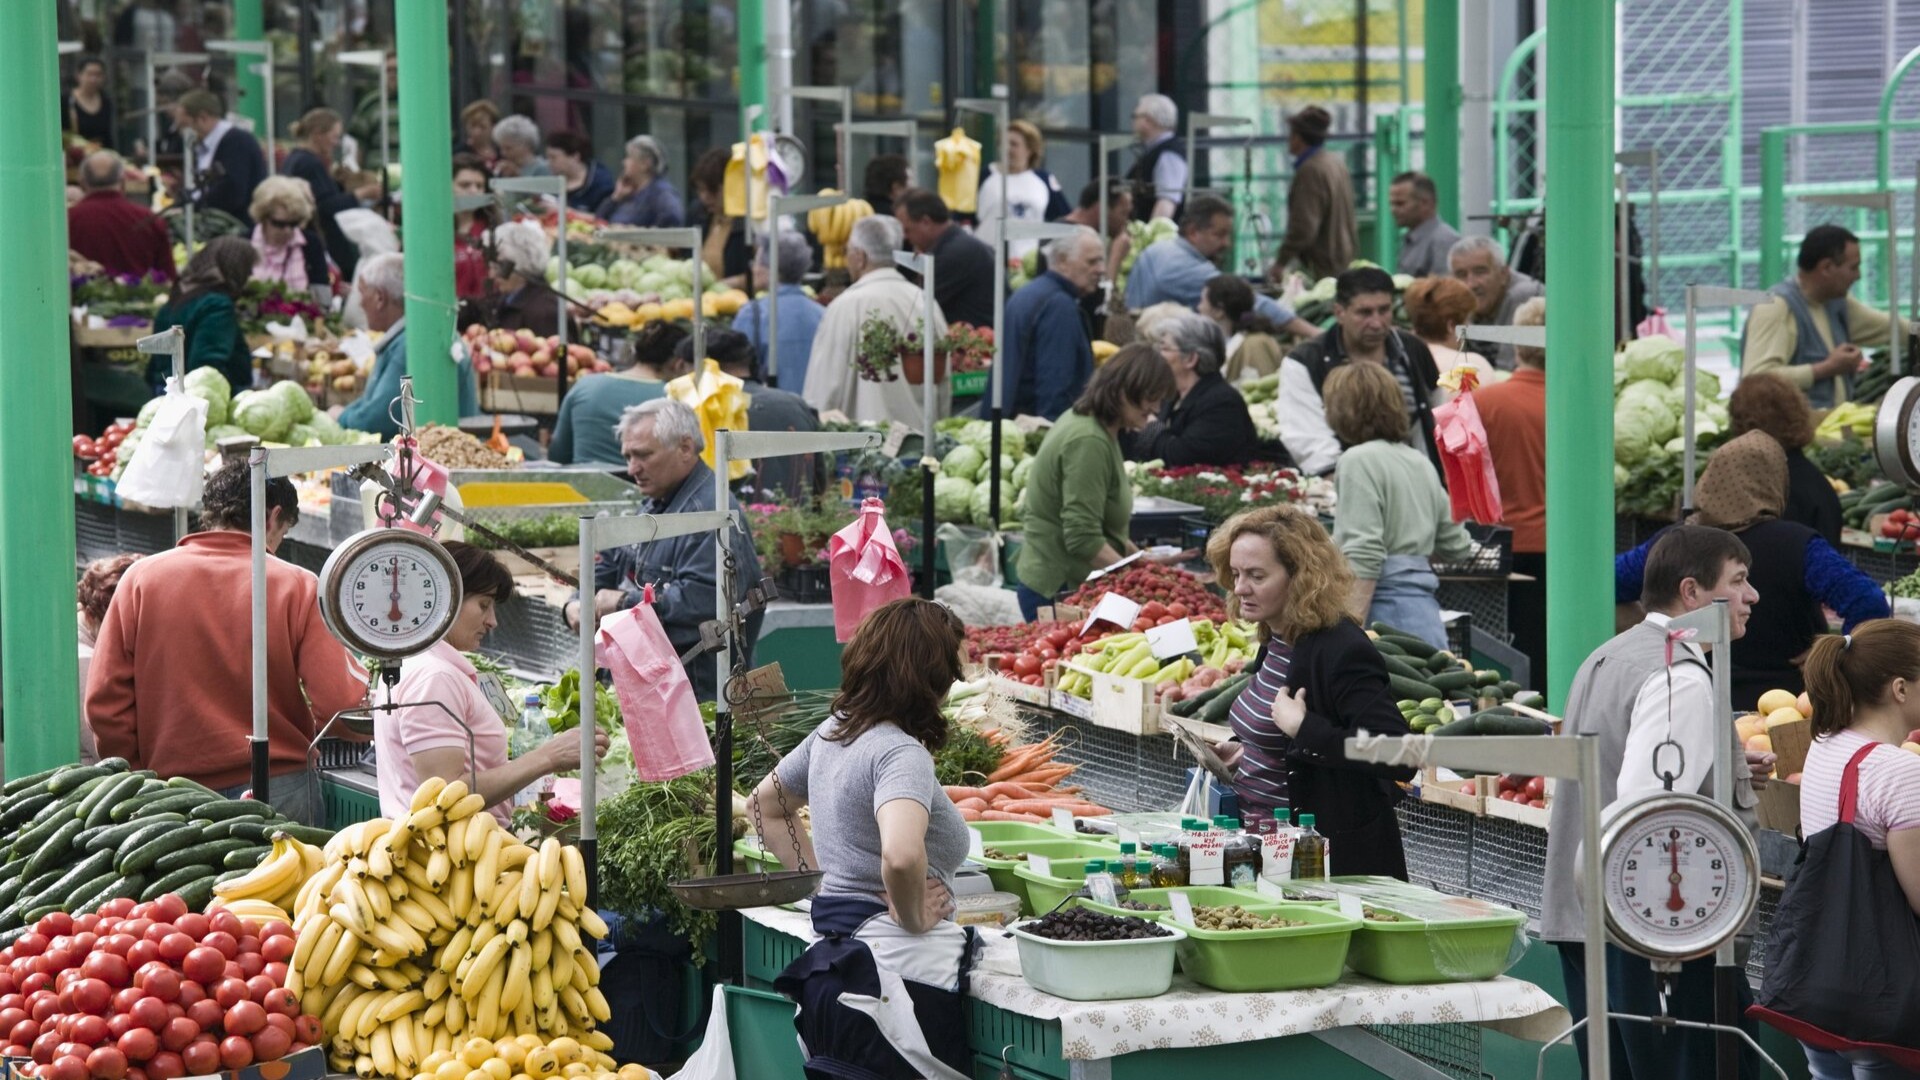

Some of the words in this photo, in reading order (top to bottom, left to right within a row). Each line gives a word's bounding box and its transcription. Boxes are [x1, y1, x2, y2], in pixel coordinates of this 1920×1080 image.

[357, 582, 365, 590] 8
[356, 603, 364, 611] 7
[370, 618, 378, 626] 6
[412, 617, 419, 625] 4
[480, 676, 506, 714] 15
[1669, 830, 1680, 839] 0
[1646, 838, 1653, 847] 1
[1696, 838, 1706, 847] 9
[1627, 860, 1636, 870] 2
[1711, 860, 1721, 869] 8
[1626, 888, 1636, 897] 3
[1712, 887, 1721, 896] 7
[1643, 908, 1652, 917] 4
[1696, 908, 1706, 917] 6
[1670, 917, 1679, 926] 5
